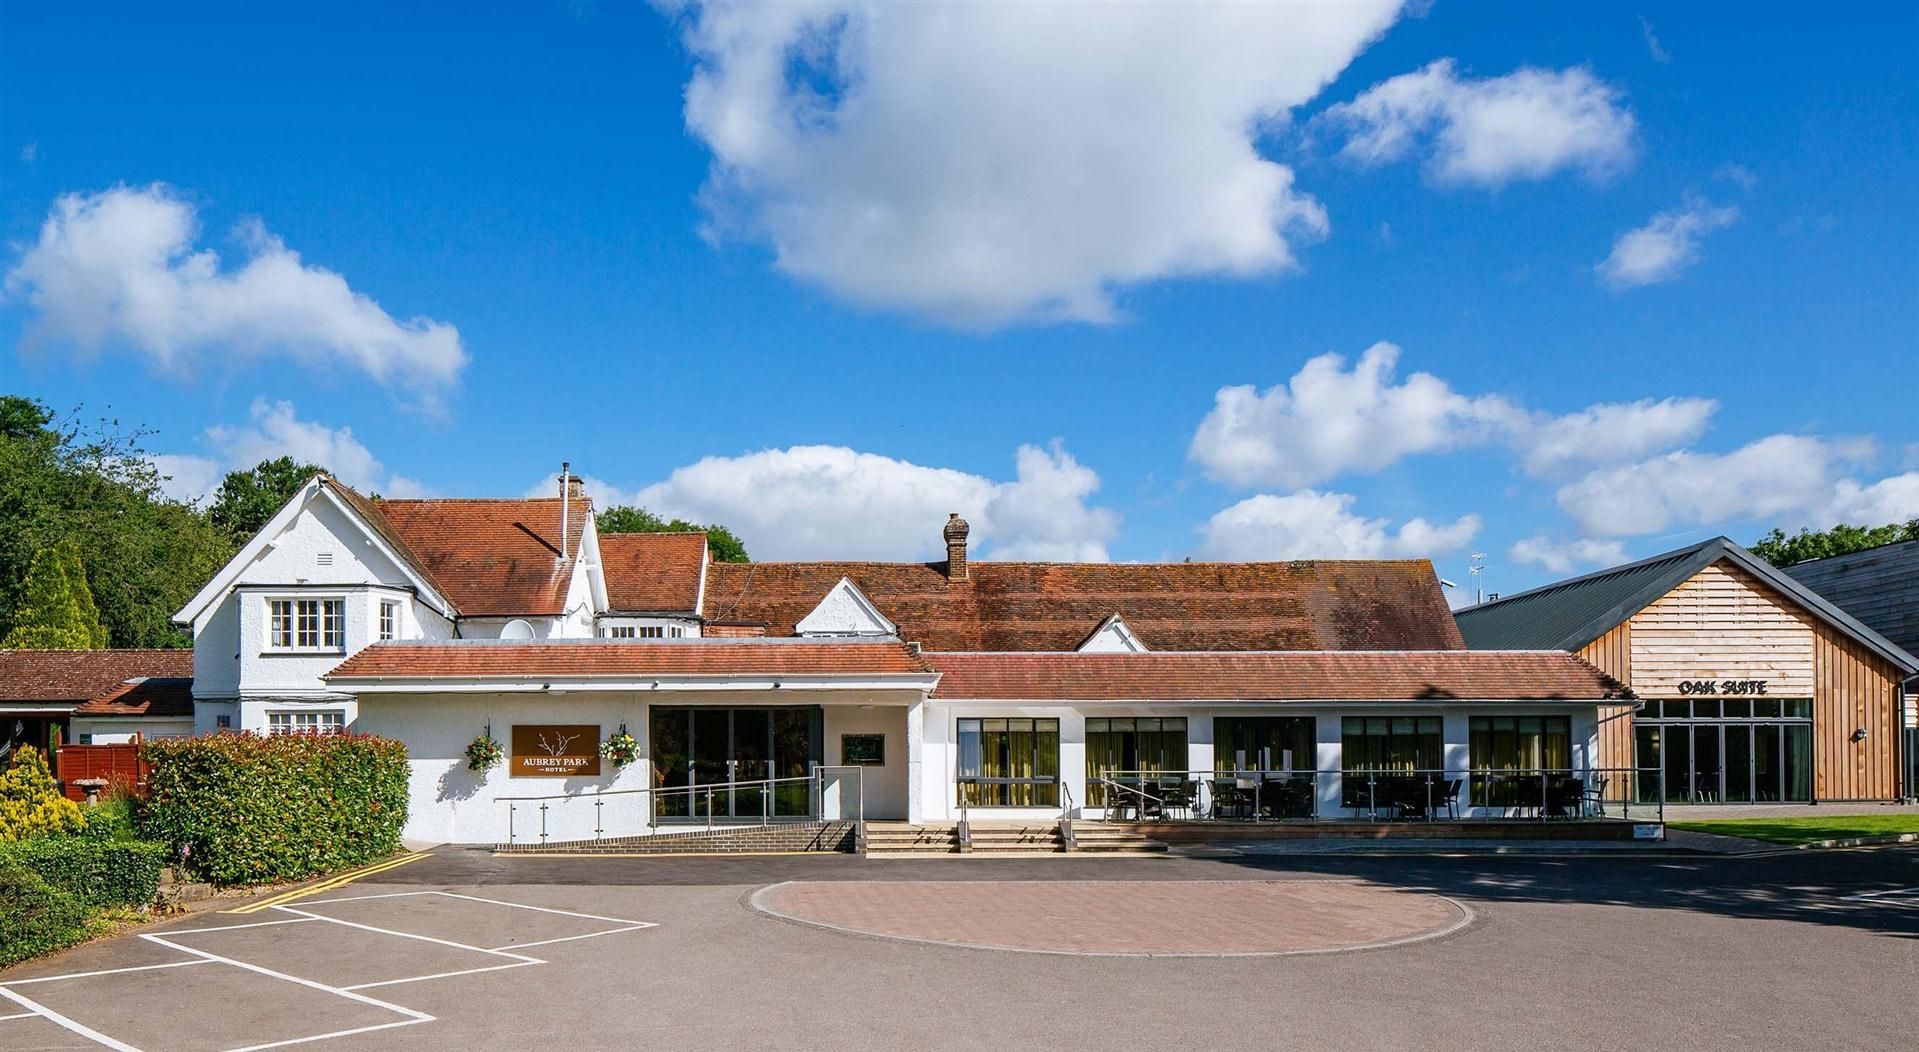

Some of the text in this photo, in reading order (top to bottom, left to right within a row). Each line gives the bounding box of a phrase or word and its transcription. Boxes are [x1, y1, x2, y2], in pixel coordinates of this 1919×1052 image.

[1678, 680, 1768, 695] OAK SUITE
[523, 758, 589, 766] AUBREY PARK
